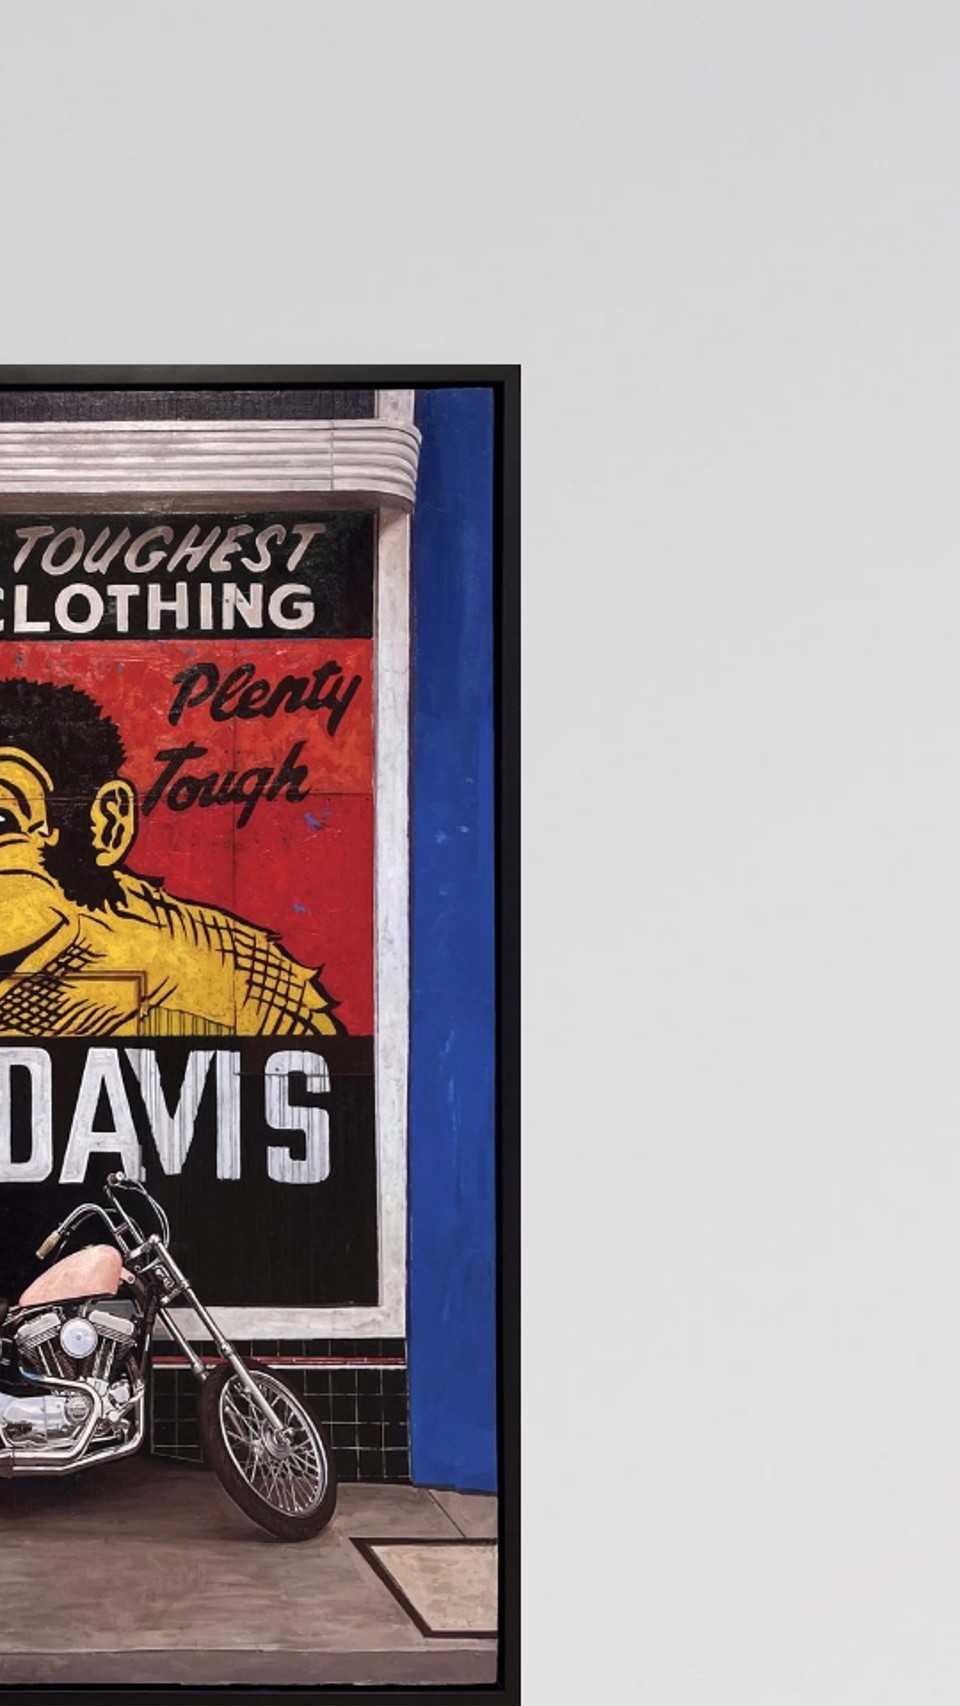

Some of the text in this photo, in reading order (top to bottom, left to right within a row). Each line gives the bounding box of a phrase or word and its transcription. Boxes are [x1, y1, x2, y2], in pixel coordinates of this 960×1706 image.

[15, 522, 327, 575] TOUGHEST
[168, 661, 363, 736] Plenty
[143, 742, 311, 828] Tough
